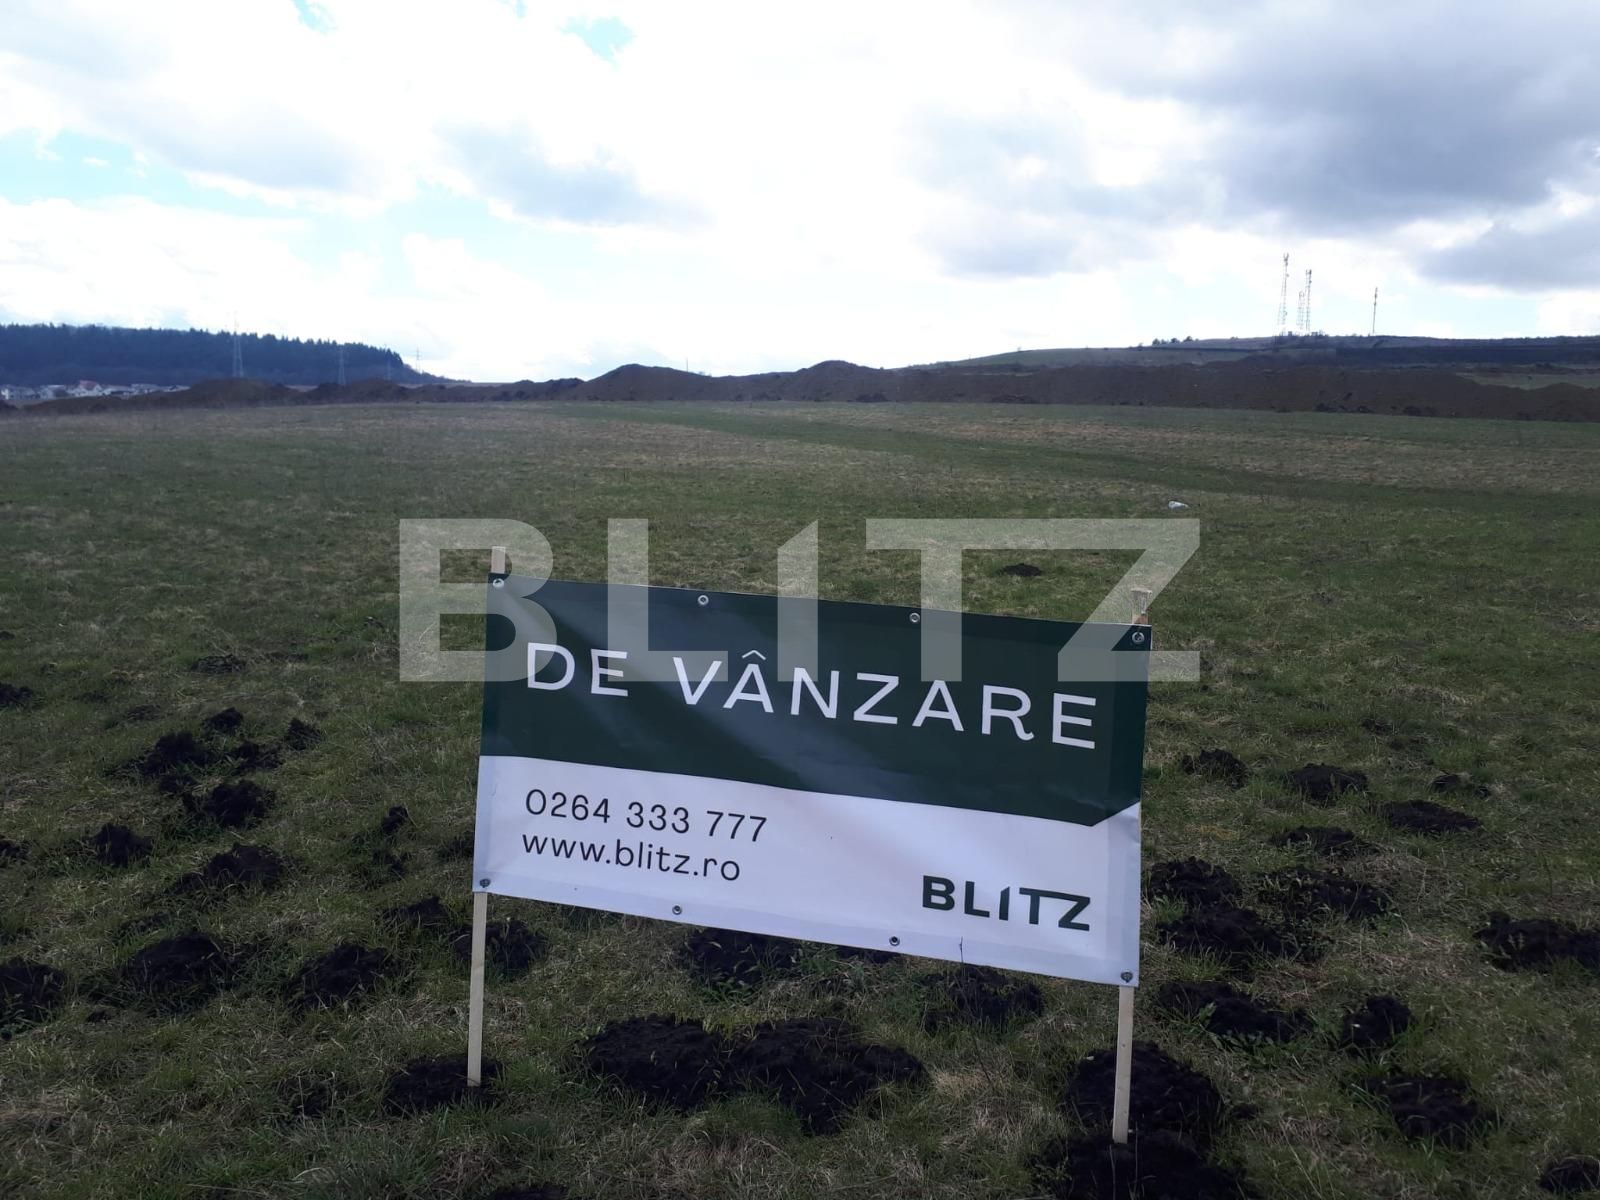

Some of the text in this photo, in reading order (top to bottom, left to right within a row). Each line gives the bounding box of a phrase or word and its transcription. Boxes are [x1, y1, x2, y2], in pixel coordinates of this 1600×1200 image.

[527, 642, 1097, 750] DE VÂNZARE
[525, 789, 767, 842] 0264 333 777
[522, 833, 740, 881] www.blitz.ro
[922, 875, 1091, 931] BLITZ
